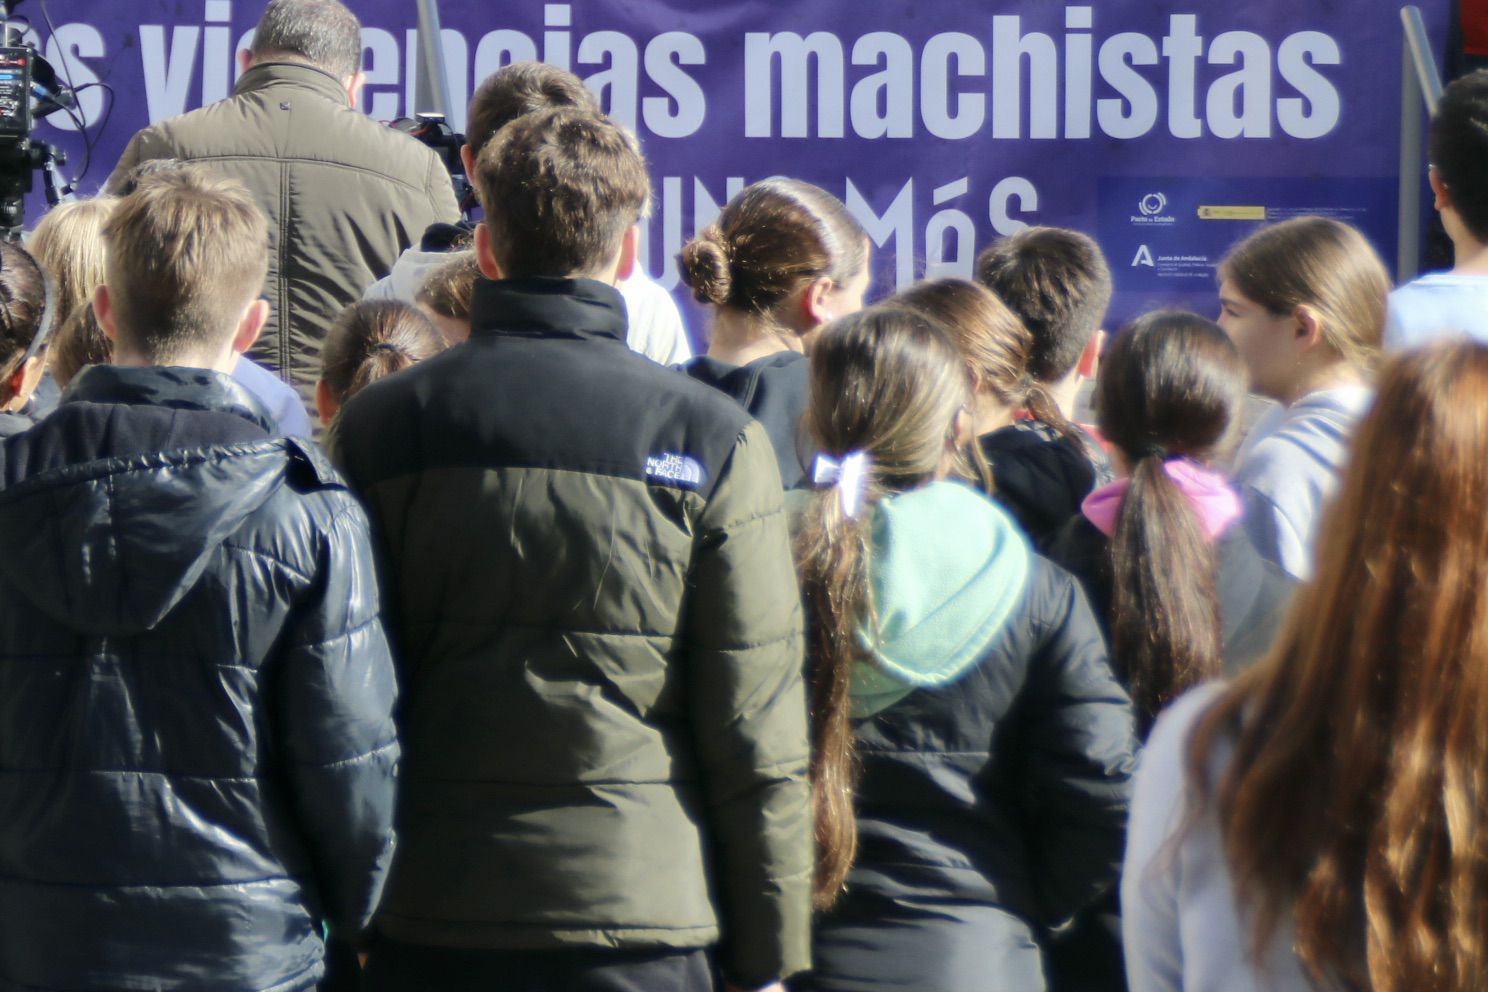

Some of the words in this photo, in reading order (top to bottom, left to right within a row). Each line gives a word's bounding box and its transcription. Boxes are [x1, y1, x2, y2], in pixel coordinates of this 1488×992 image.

[139, 0, 707, 139] viencias
[744, 6, 1341, 139] machistas
[646, 457, 682, 473] NORTH
[663, 452, 683, 465] THE
[654, 467, 682, 479] FACE
